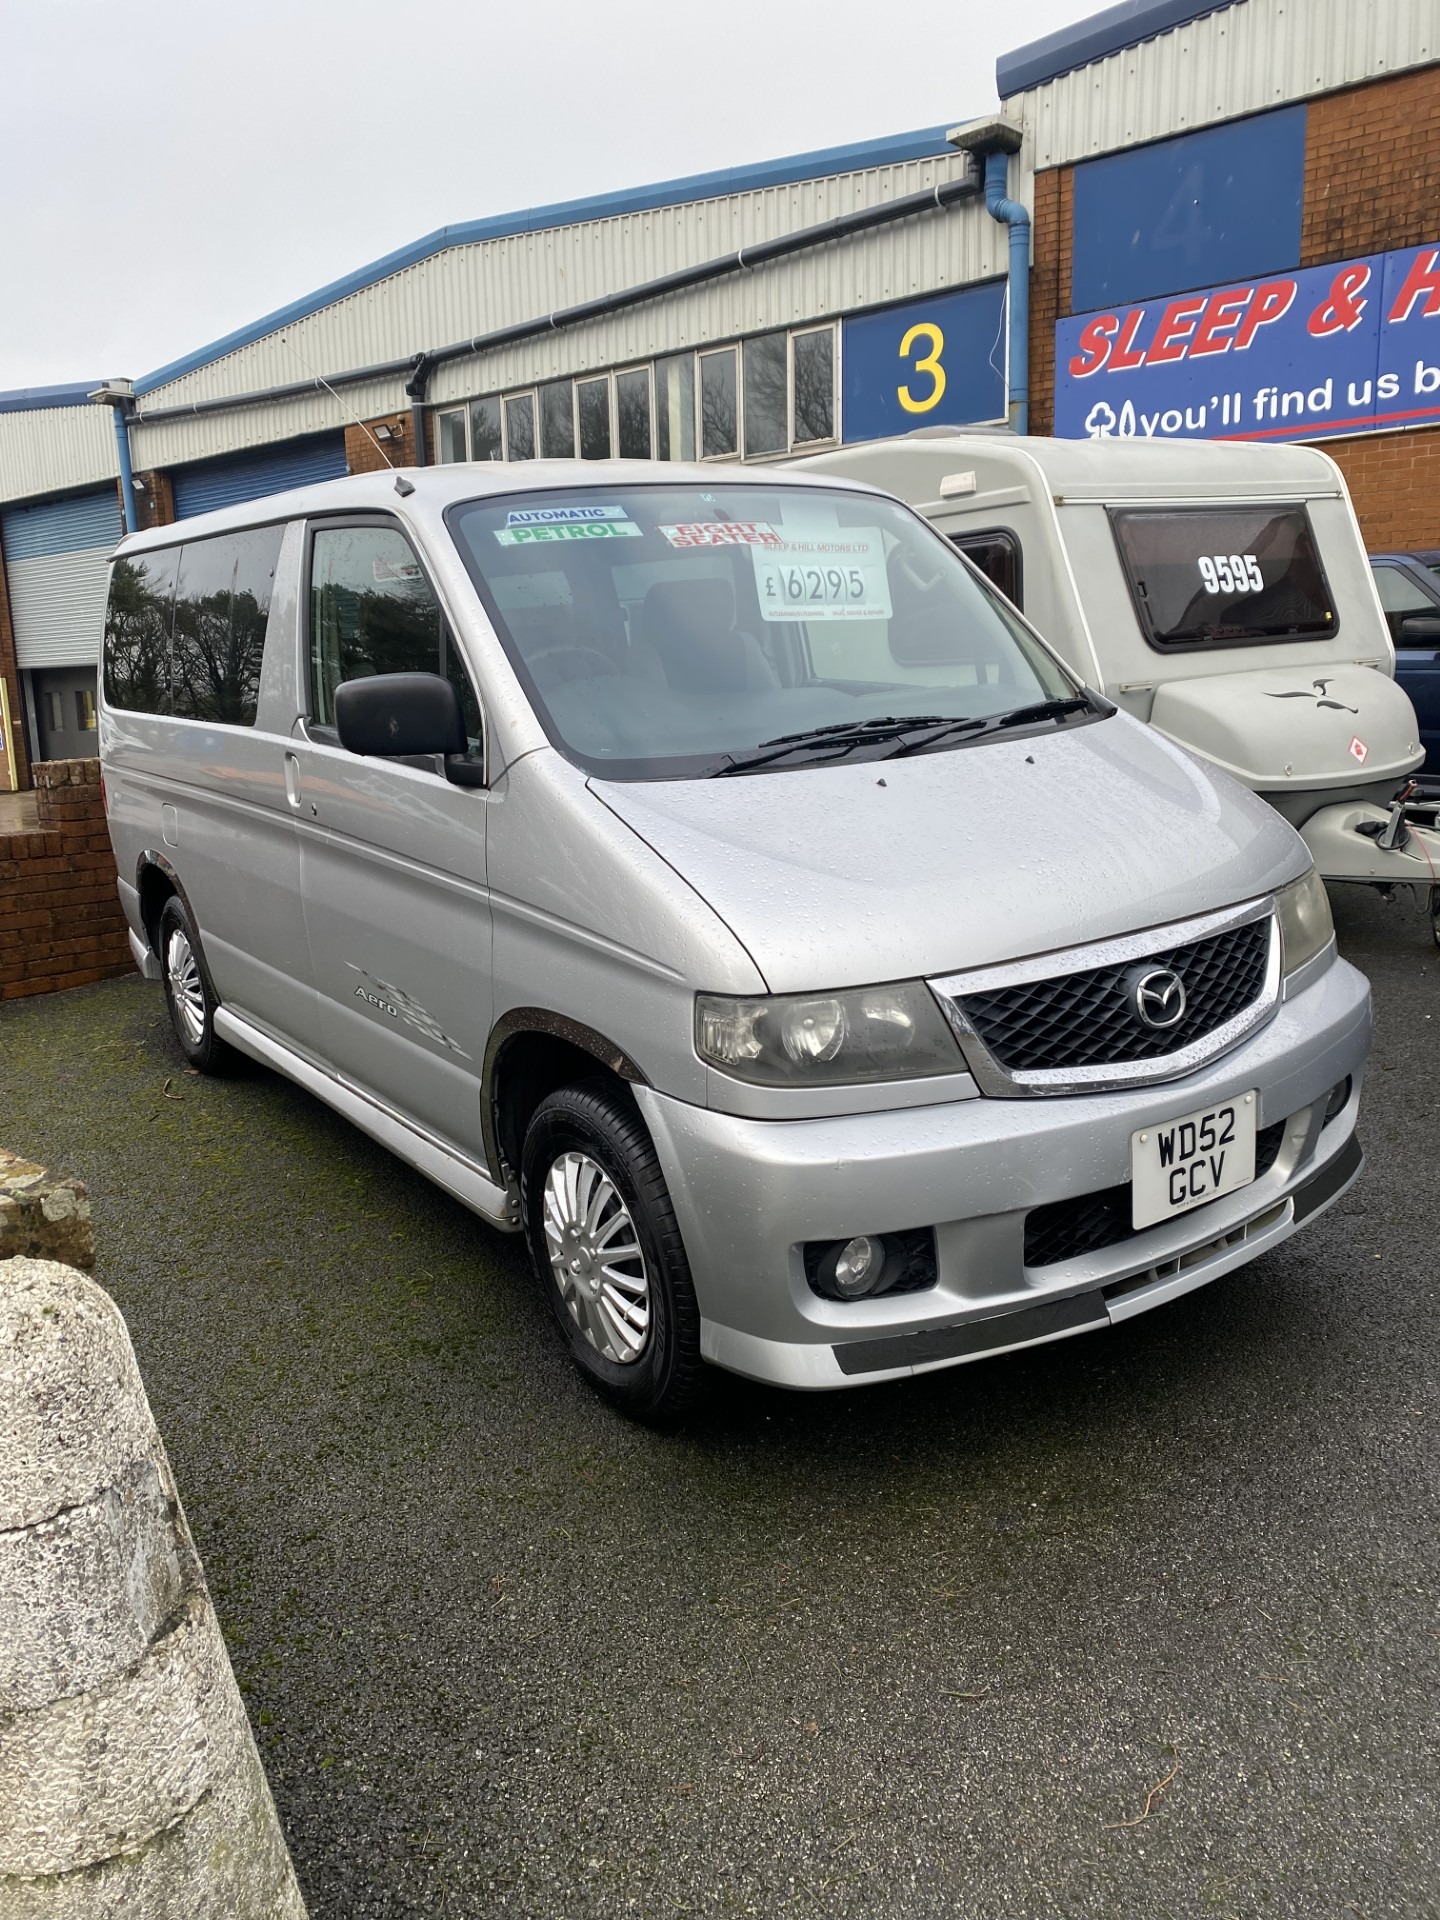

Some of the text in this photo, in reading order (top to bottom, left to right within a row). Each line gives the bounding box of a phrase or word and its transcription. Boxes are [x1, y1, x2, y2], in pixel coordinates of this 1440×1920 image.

[1069, 280, 1297, 377] SLEEP
[1307, 264, 1371, 336] &
[897, 322, 946, 412] 3
[1253, 379, 1332, 420] find
[1348, 371, 1400, 406] us
[509, 508, 605, 522] AUTOMATIC
[511, 523, 628, 542] PETROL
[675, 523, 756, 535] EIGHT
[672, 532, 779, 545] SEATER
[817, 544, 850, 552] MOTORS
[852, 544, 868, 552] LTD
[1198, 554, 1264, 593] 9595
[354, 985, 398, 1018] Aero
[1158, 1107, 1235, 1168] WD52
[1169, 1150, 1225, 1205] GCV
